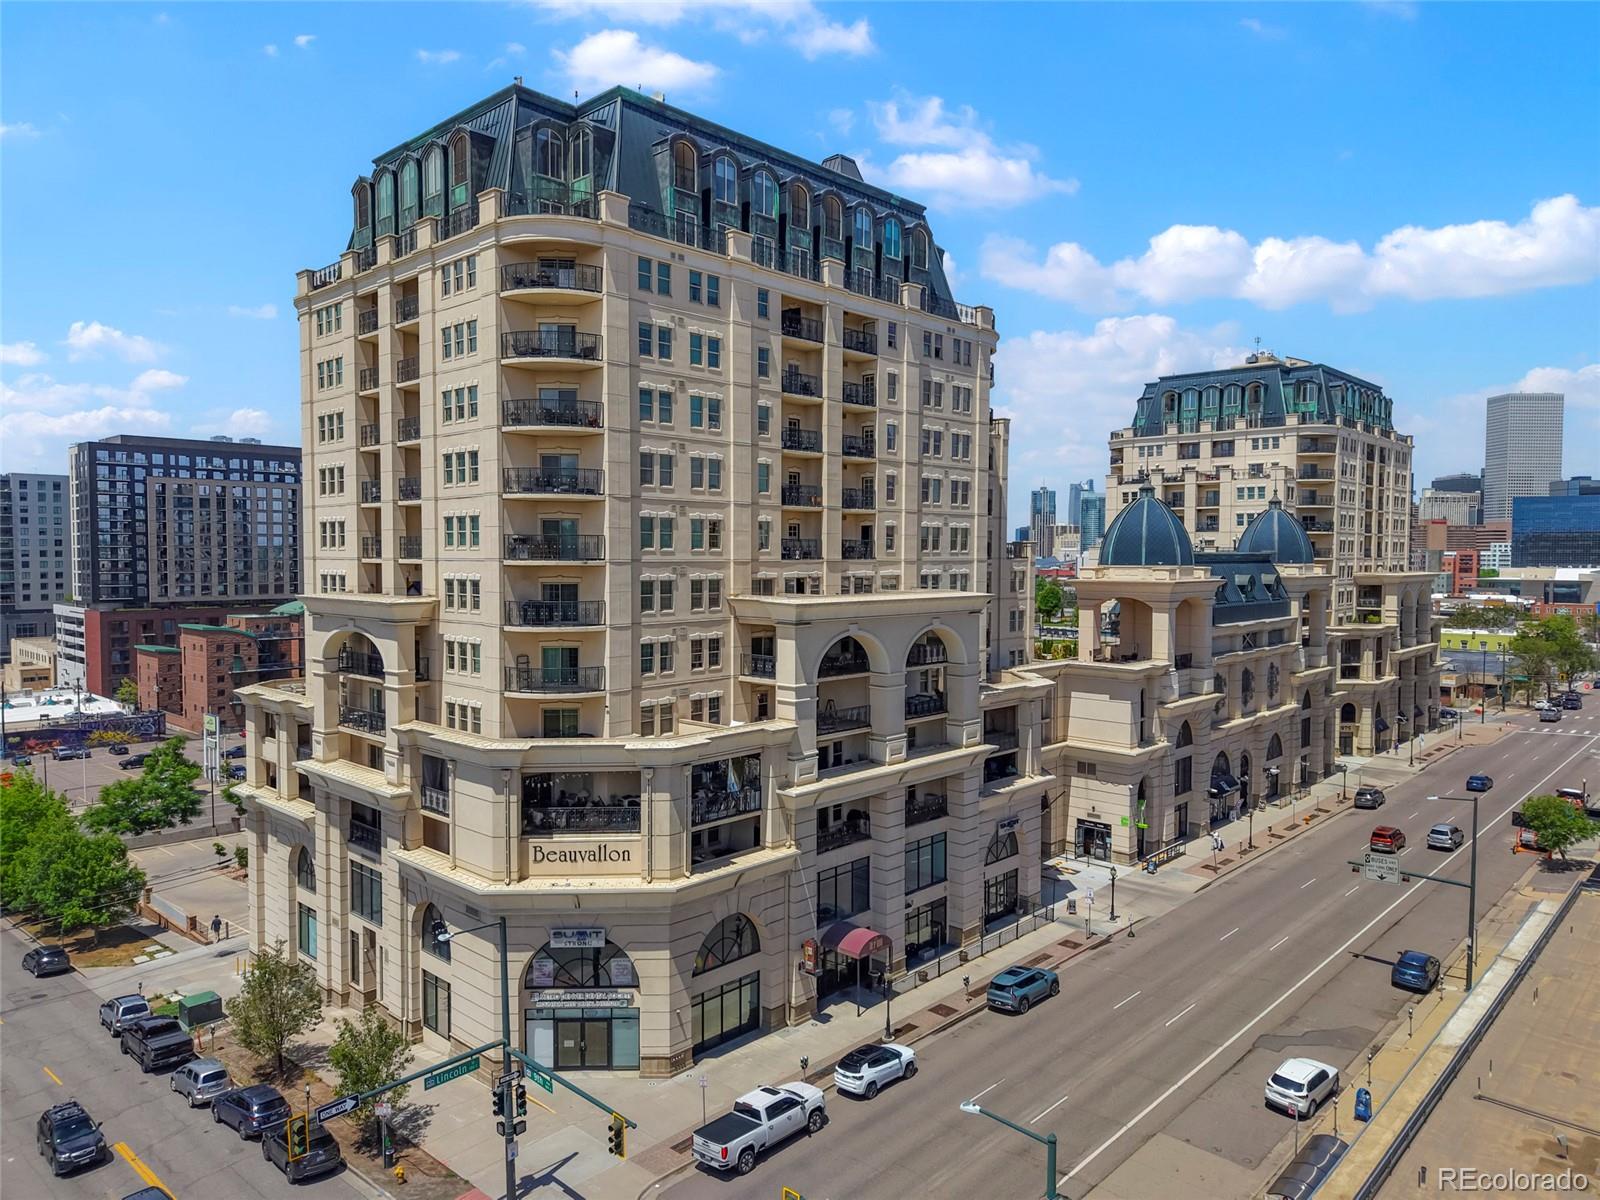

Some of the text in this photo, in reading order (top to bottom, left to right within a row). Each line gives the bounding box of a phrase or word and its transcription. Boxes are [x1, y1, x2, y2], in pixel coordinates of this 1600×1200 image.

[532, 843, 631, 863] Beauvallon
[435, 1065, 468, 1085] Lincoln
[321, 1103, 347, 1118] ONE WAY
